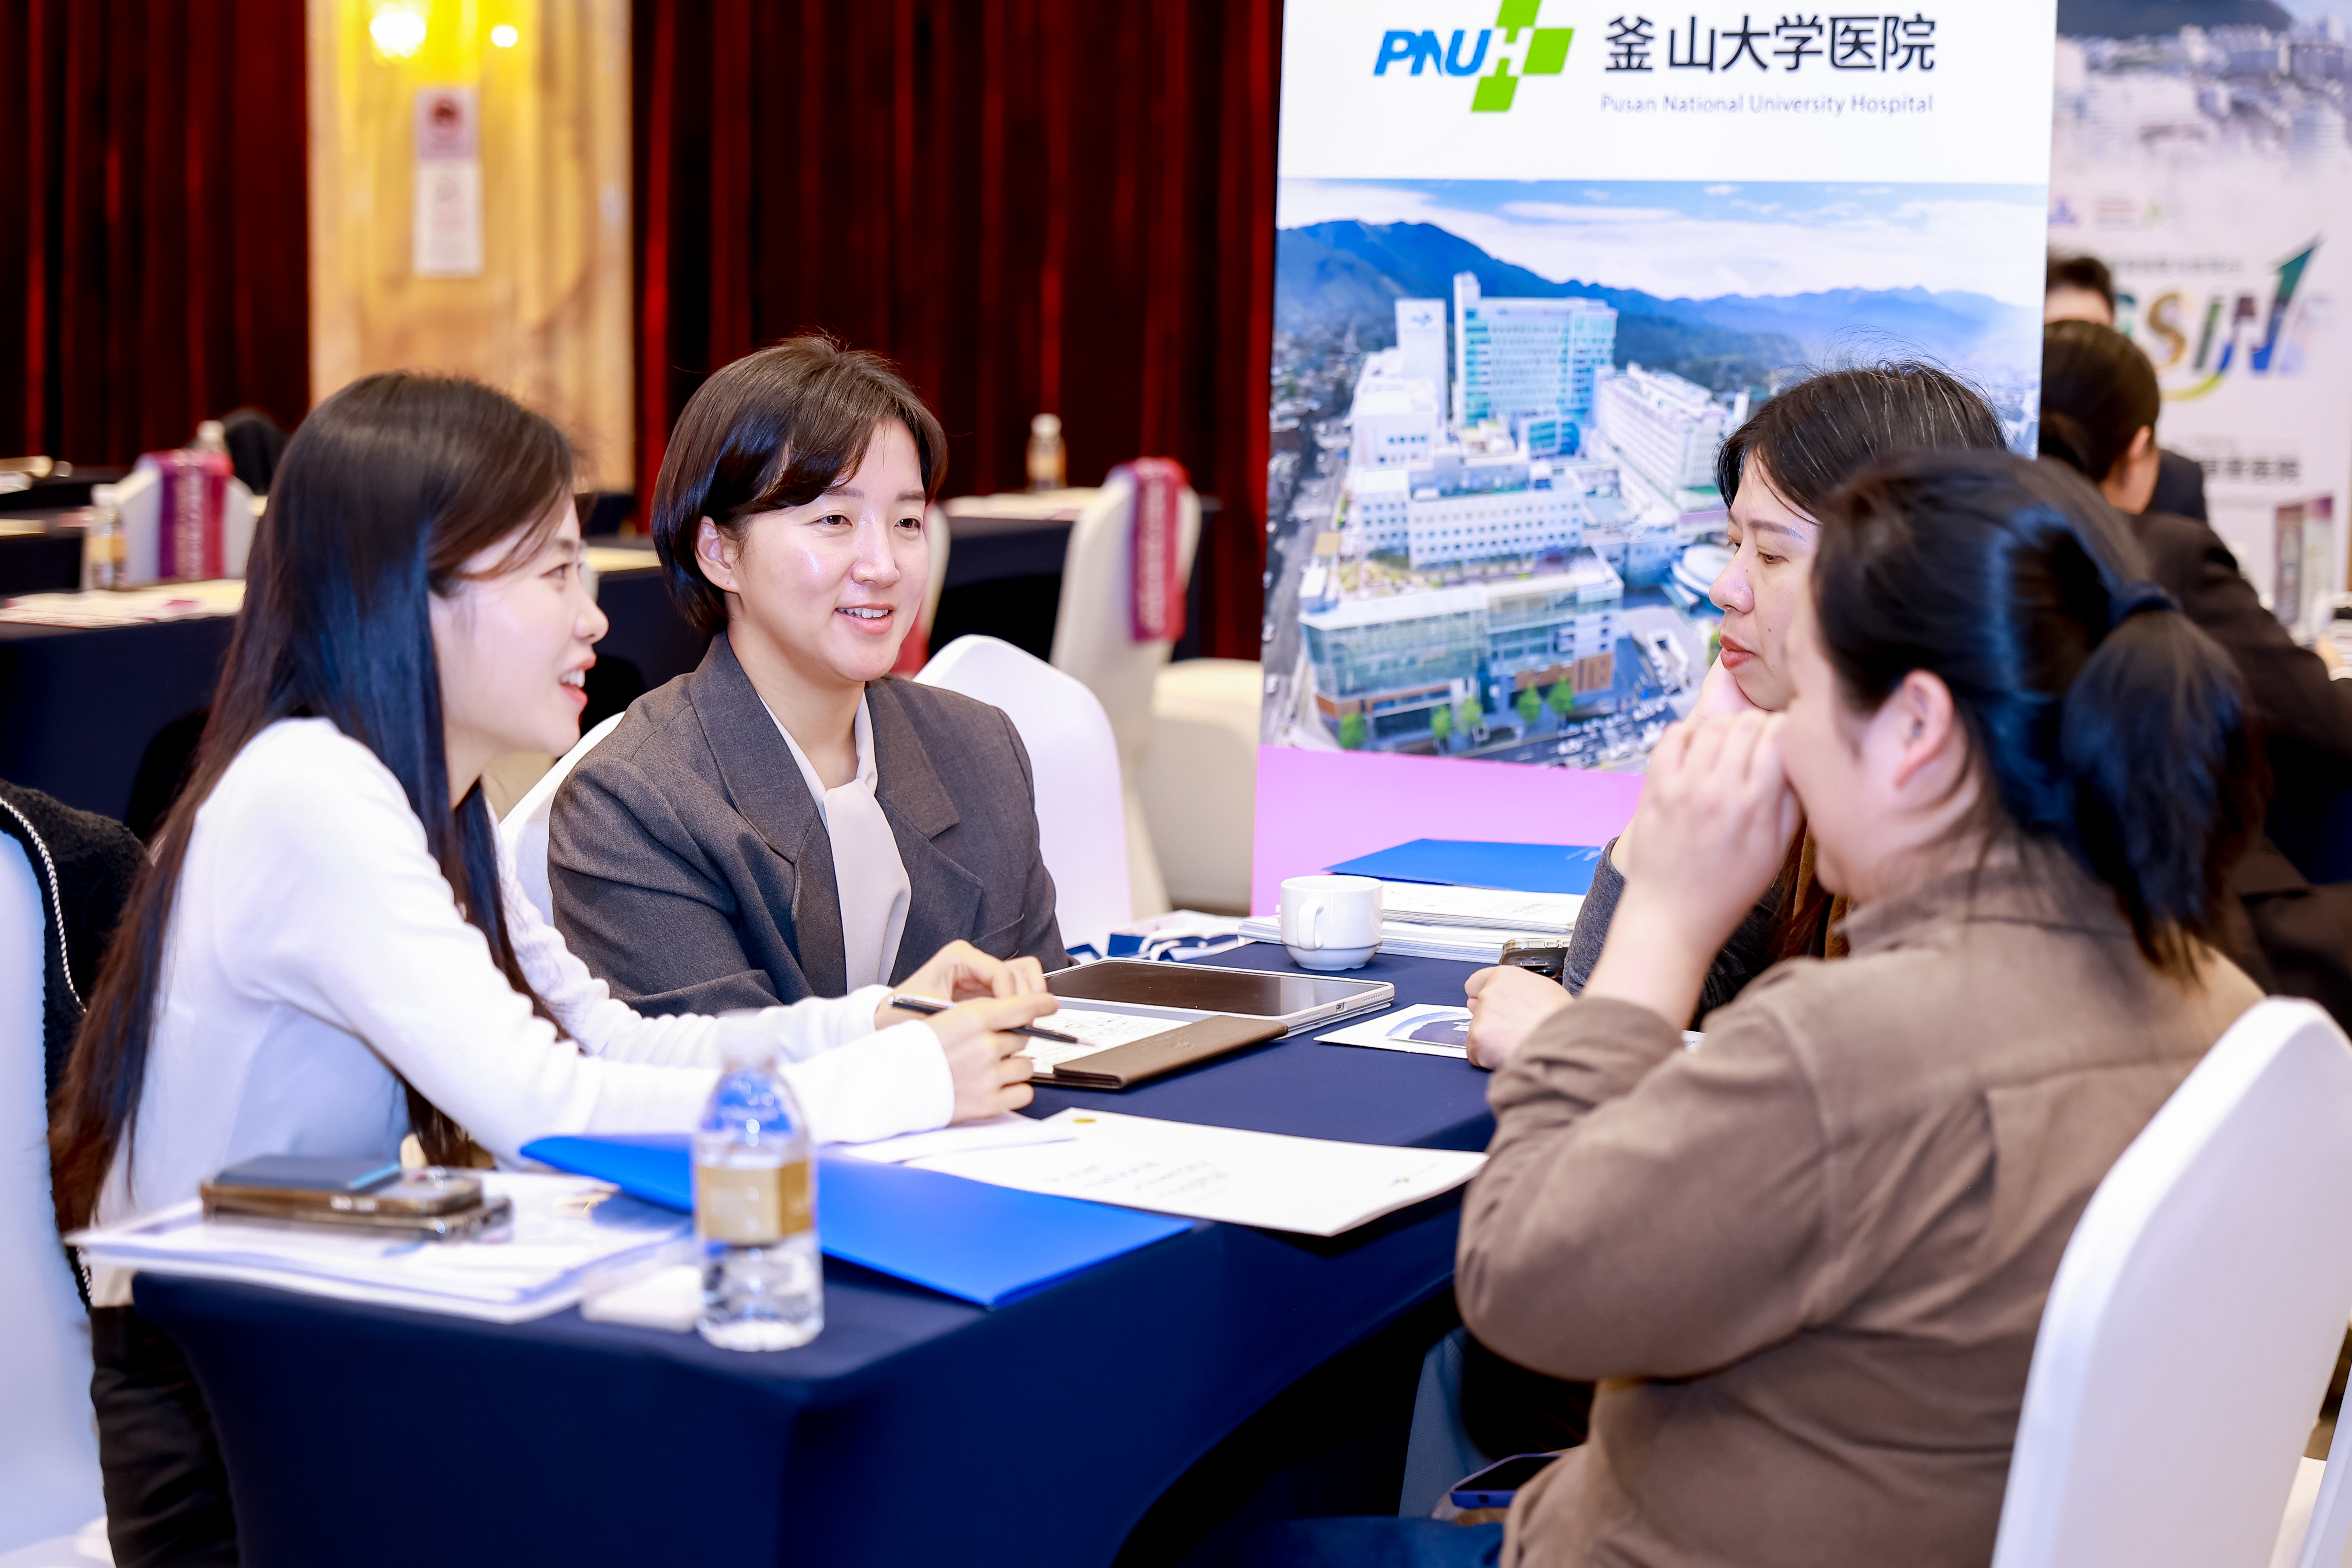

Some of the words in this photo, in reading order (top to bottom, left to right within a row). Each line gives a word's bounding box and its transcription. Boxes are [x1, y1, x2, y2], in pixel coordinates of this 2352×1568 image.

[1605, 13, 1935, 72] 釜山大学医院
[1601, 94, 1657, 113] Pusan
[1663, 93, 1744, 113] National
[1749, 94, 1845, 117] University
[1851, 94, 1933, 117] Hospital
